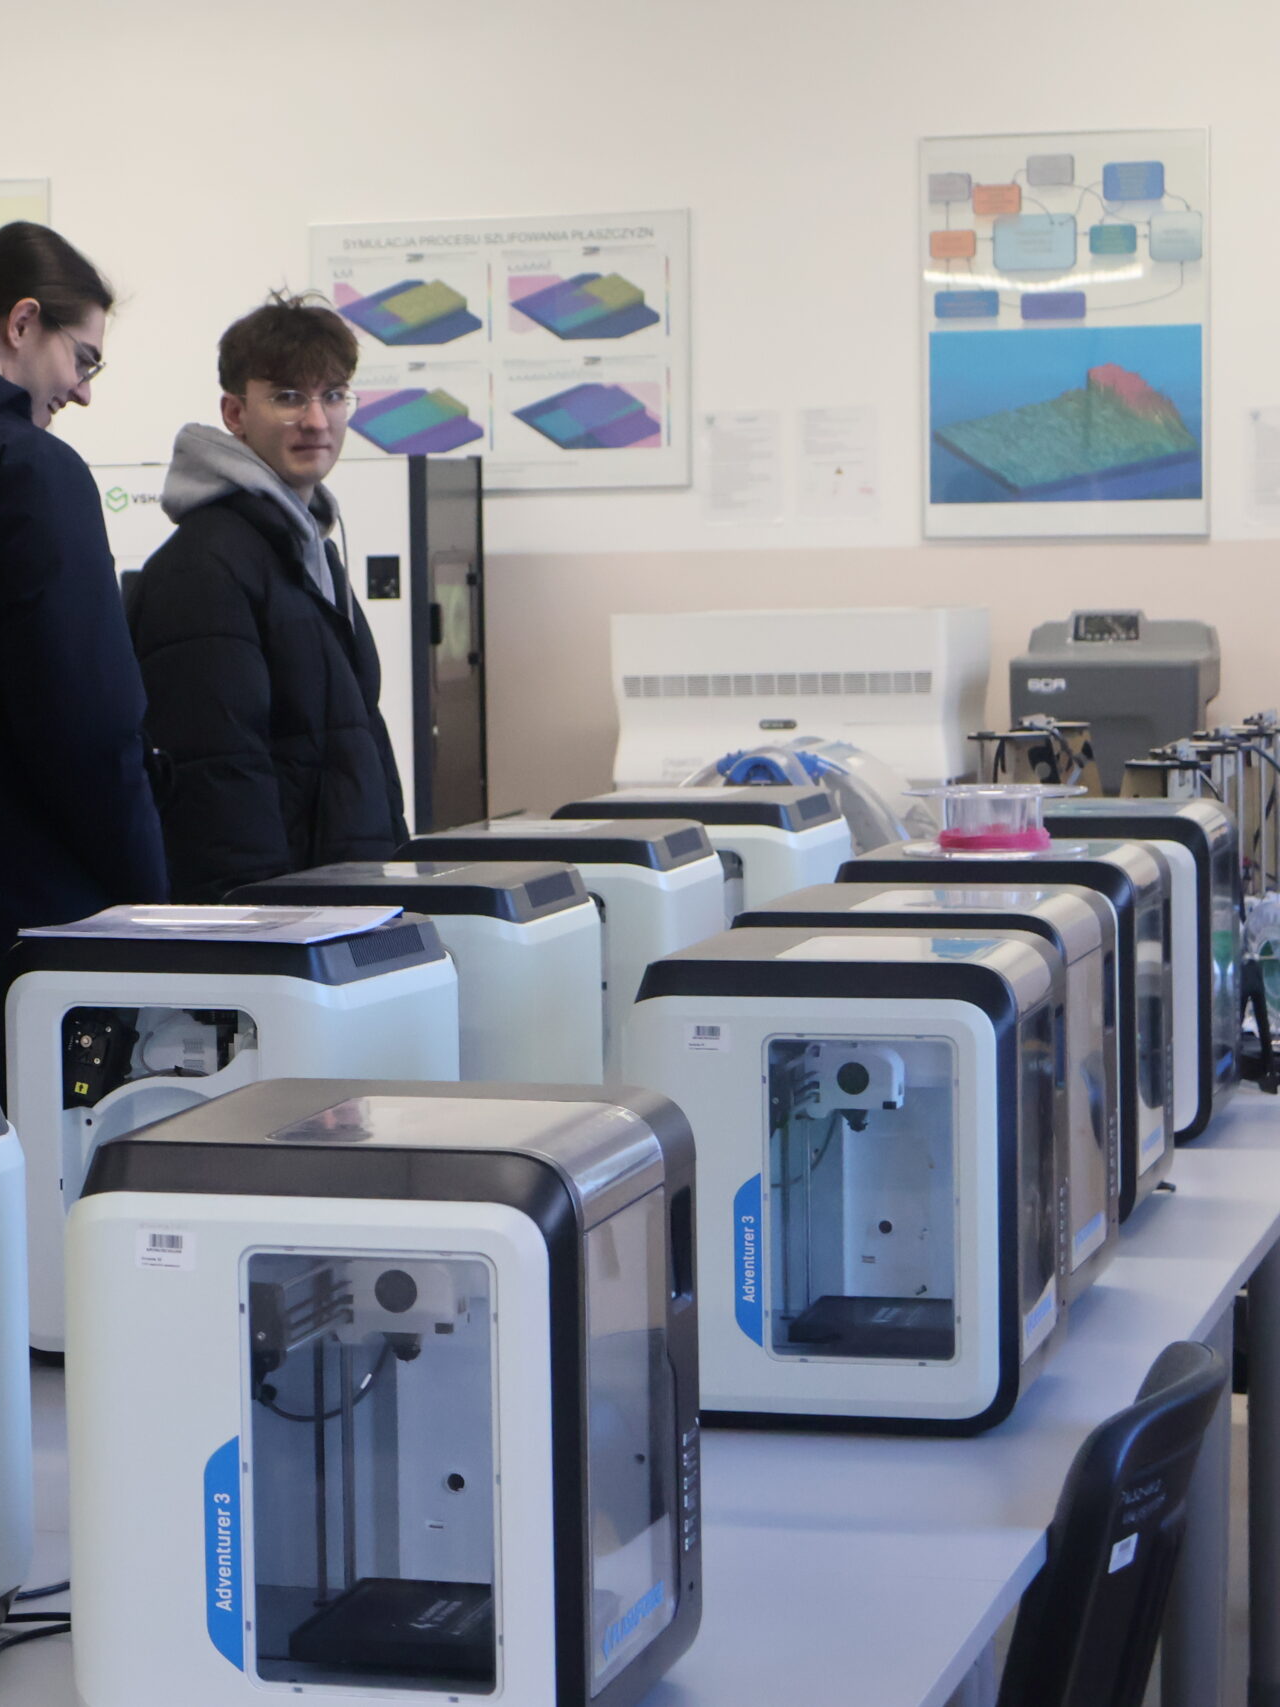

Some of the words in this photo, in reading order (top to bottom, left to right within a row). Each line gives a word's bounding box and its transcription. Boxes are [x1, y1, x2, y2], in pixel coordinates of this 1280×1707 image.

[342, 235, 417, 250] SYMULACJA
[419, 233, 480, 246] PROCESU
[484, 230, 569, 244] SZLIFOWANIA
[741, 1216, 755, 1224] 3
[742, 1226, 755, 1303] Adventurer
[213, 1493, 231, 1504] 3
[215, 1508, 232, 1612] Adventurer
